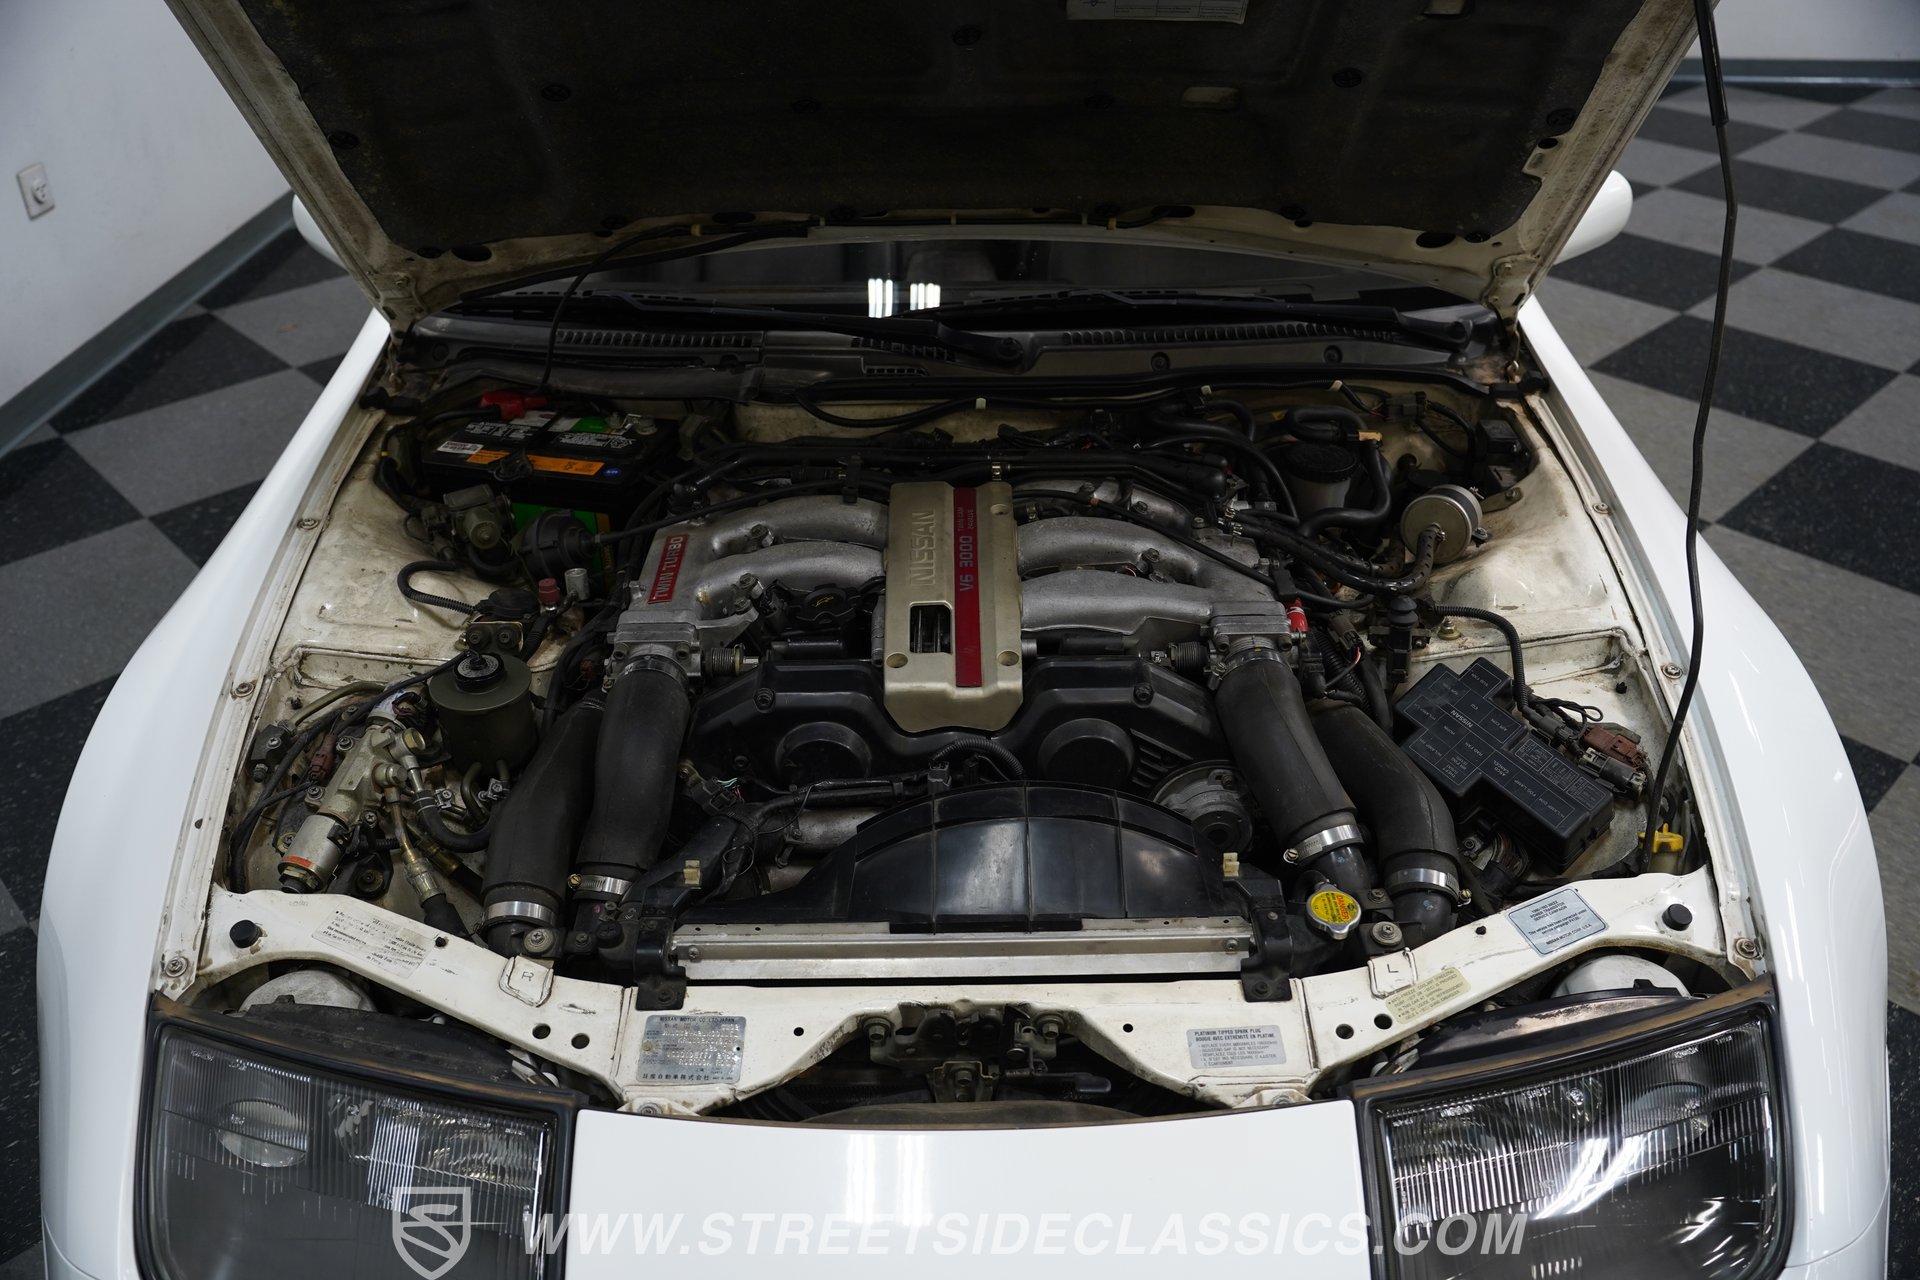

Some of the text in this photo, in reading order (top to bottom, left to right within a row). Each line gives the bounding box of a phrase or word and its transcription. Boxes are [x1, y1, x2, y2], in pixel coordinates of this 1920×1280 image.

[910, 511, 936, 586] NISSAN
[655, 536, 683, 597] TWIN TURBO
[959, 535, 976, 592] V6 3000
[1450, 709, 1472, 727] NISSAN
[1492, 760, 1509, 773] CANCEL
[1513, 779, 1527, 789] LAMP
[1335, 894, 1350, 921] DANGER
[1533, 905, 1567, 921] SERVICE CAMPAIGN
[1543, 901, 1564, 912] TRANSISTOR
[521, 971, 535, 982] R
